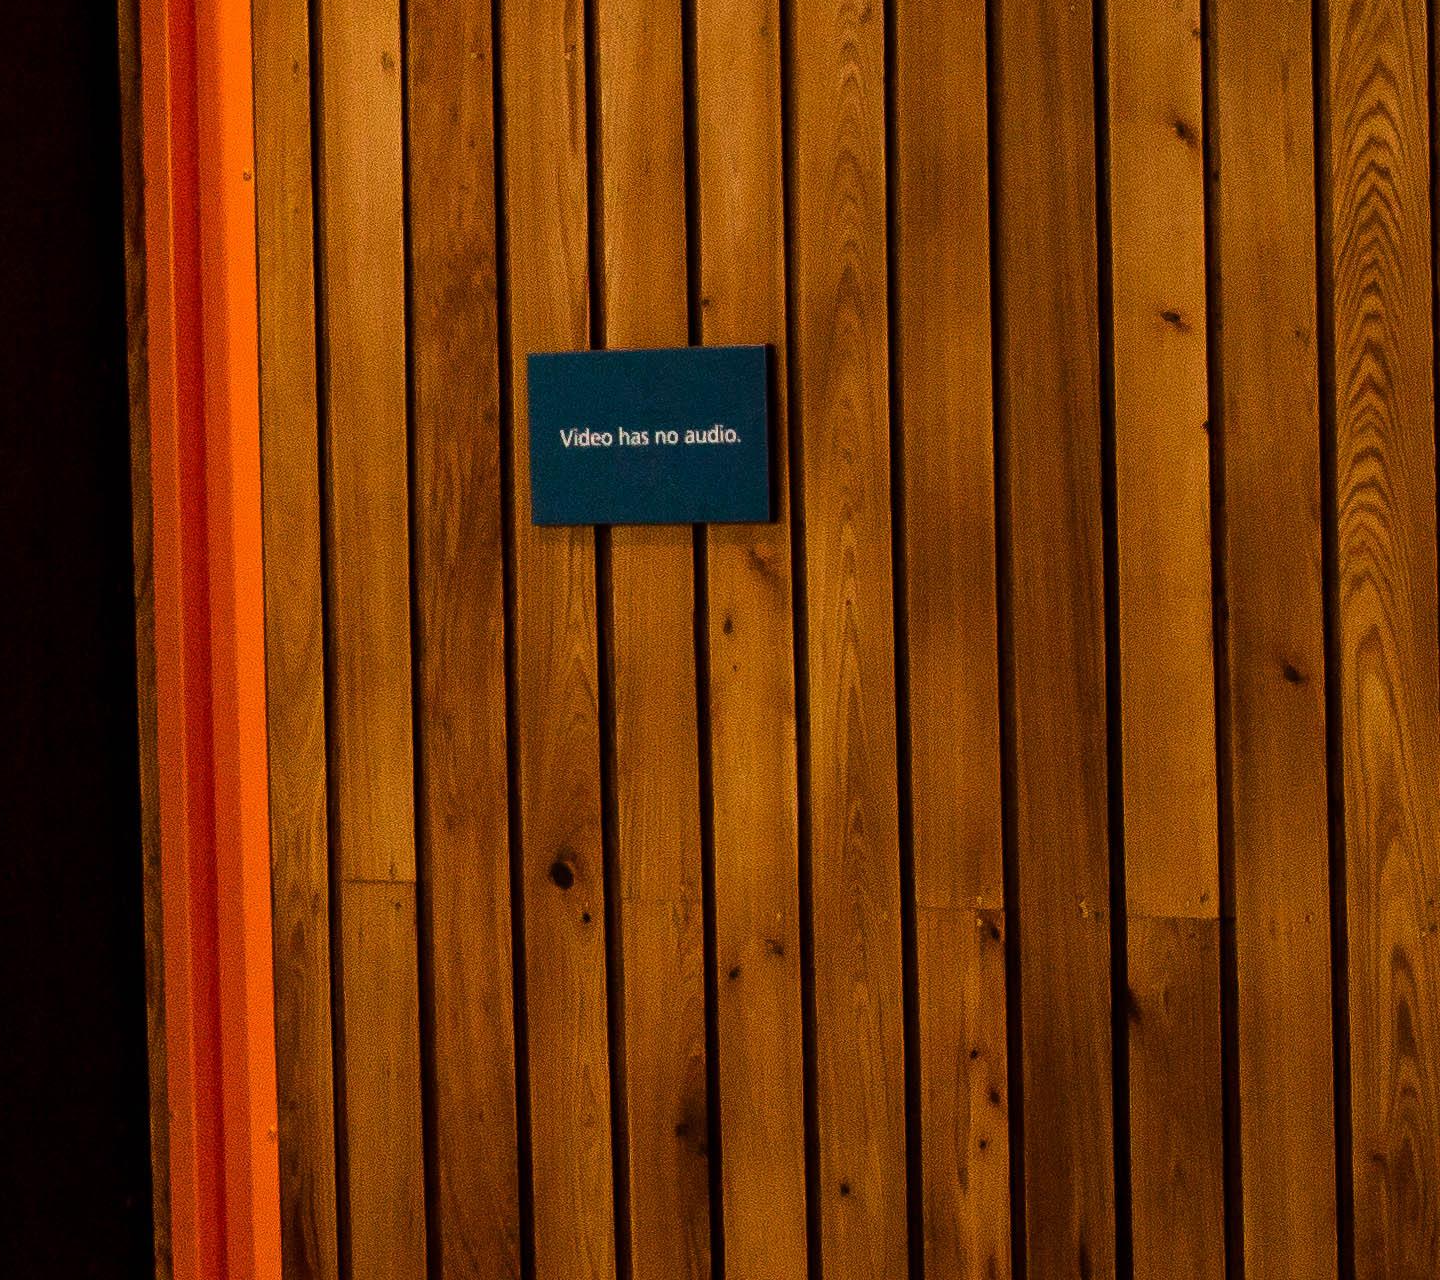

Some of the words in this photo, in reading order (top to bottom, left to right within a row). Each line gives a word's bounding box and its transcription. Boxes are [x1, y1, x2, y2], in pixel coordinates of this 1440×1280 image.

[558, 426, 614, 449] Video
[617, 425, 651, 448] has
[653, 429, 680, 446] no
[683, 423, 743, 446] audio.
